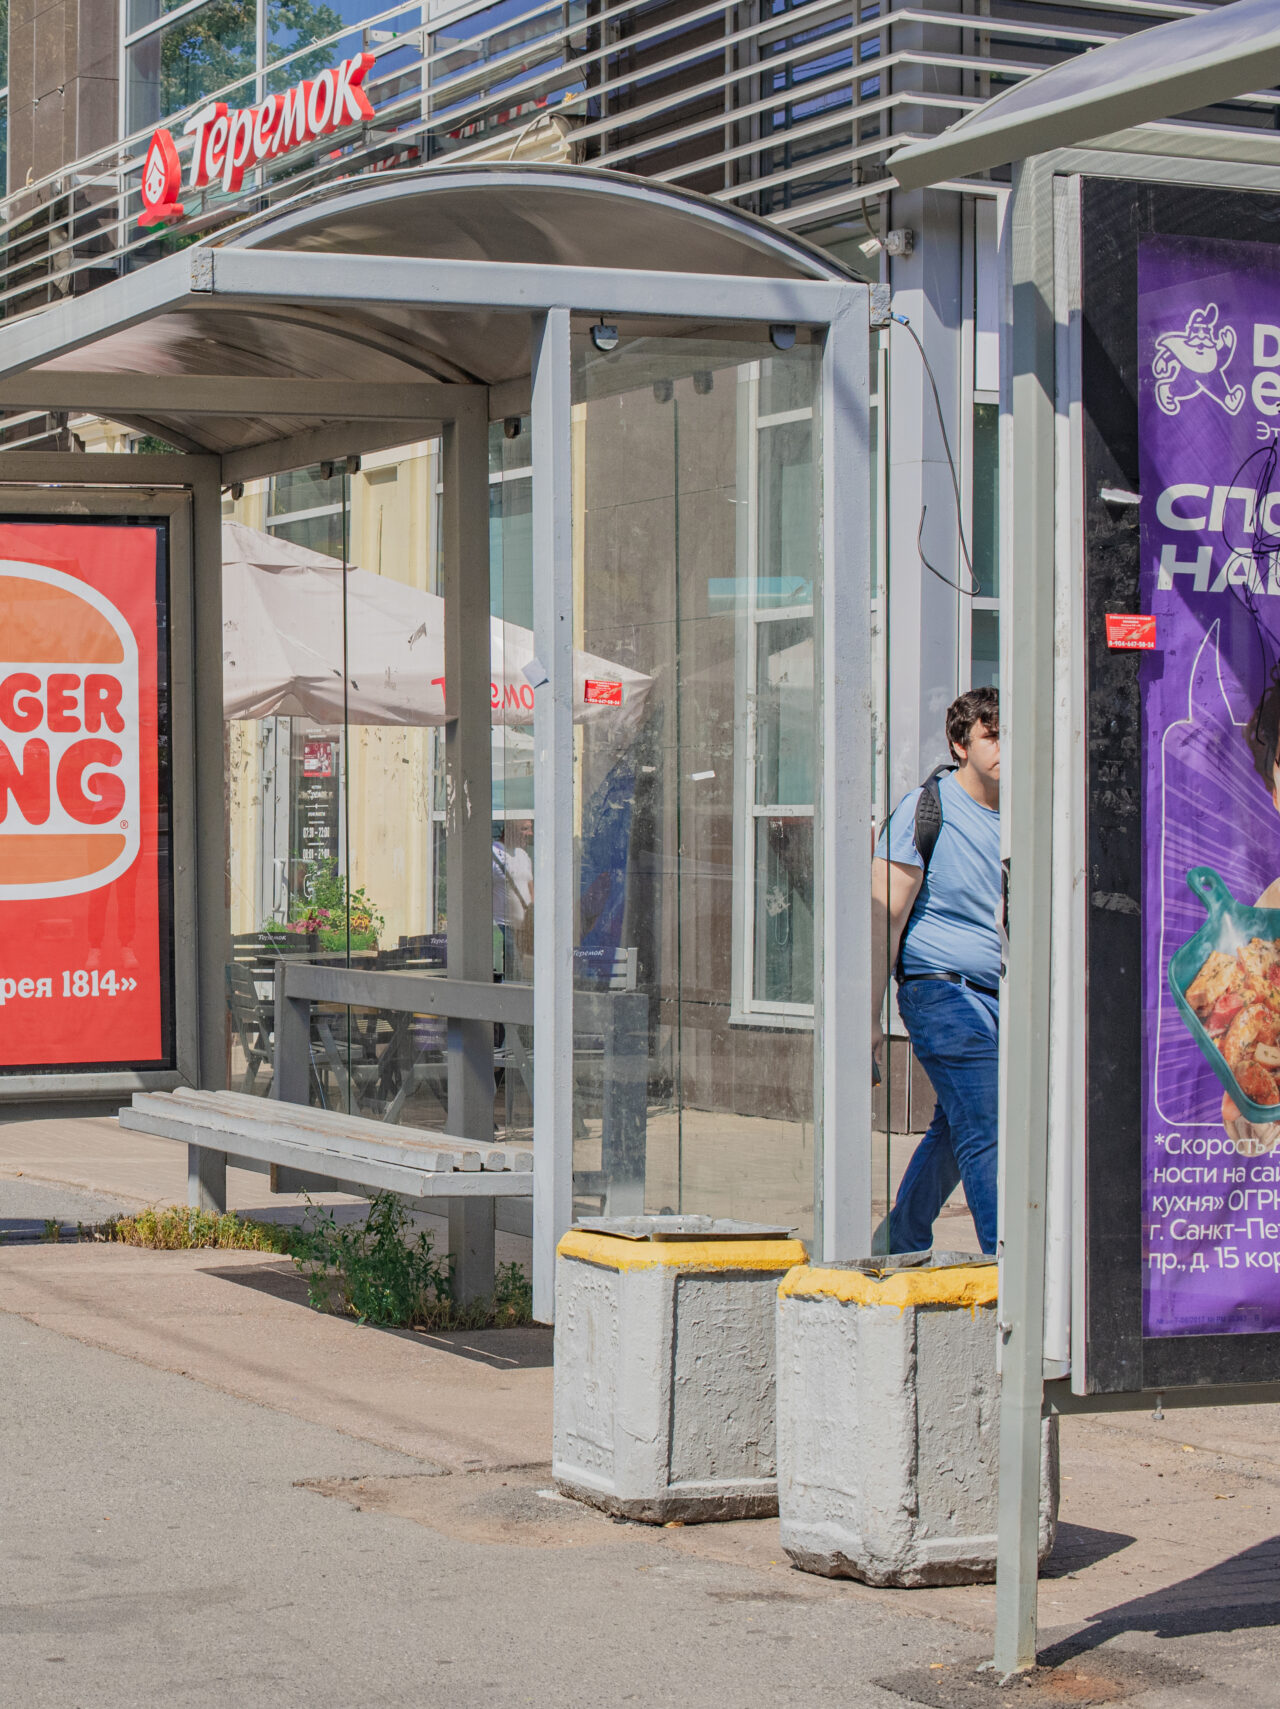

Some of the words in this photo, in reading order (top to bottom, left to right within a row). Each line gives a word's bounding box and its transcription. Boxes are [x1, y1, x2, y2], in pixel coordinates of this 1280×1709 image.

[183, 52, 376, 192] Теремок
[62, 969, 138, 997] 1814»
[1153, 1167, 1217, 1183] ности
[1223, 1167, 1246, 1183] на
[1152, 1195, 1224, 1218] кухня»
[1150, 1224, 1164, 1240] г.
[1148, 1252, 1186, 1275] пр.,
[1190, 1252, 1210, 1273] д.
[1213, 1246, 1240, 1268] 15
